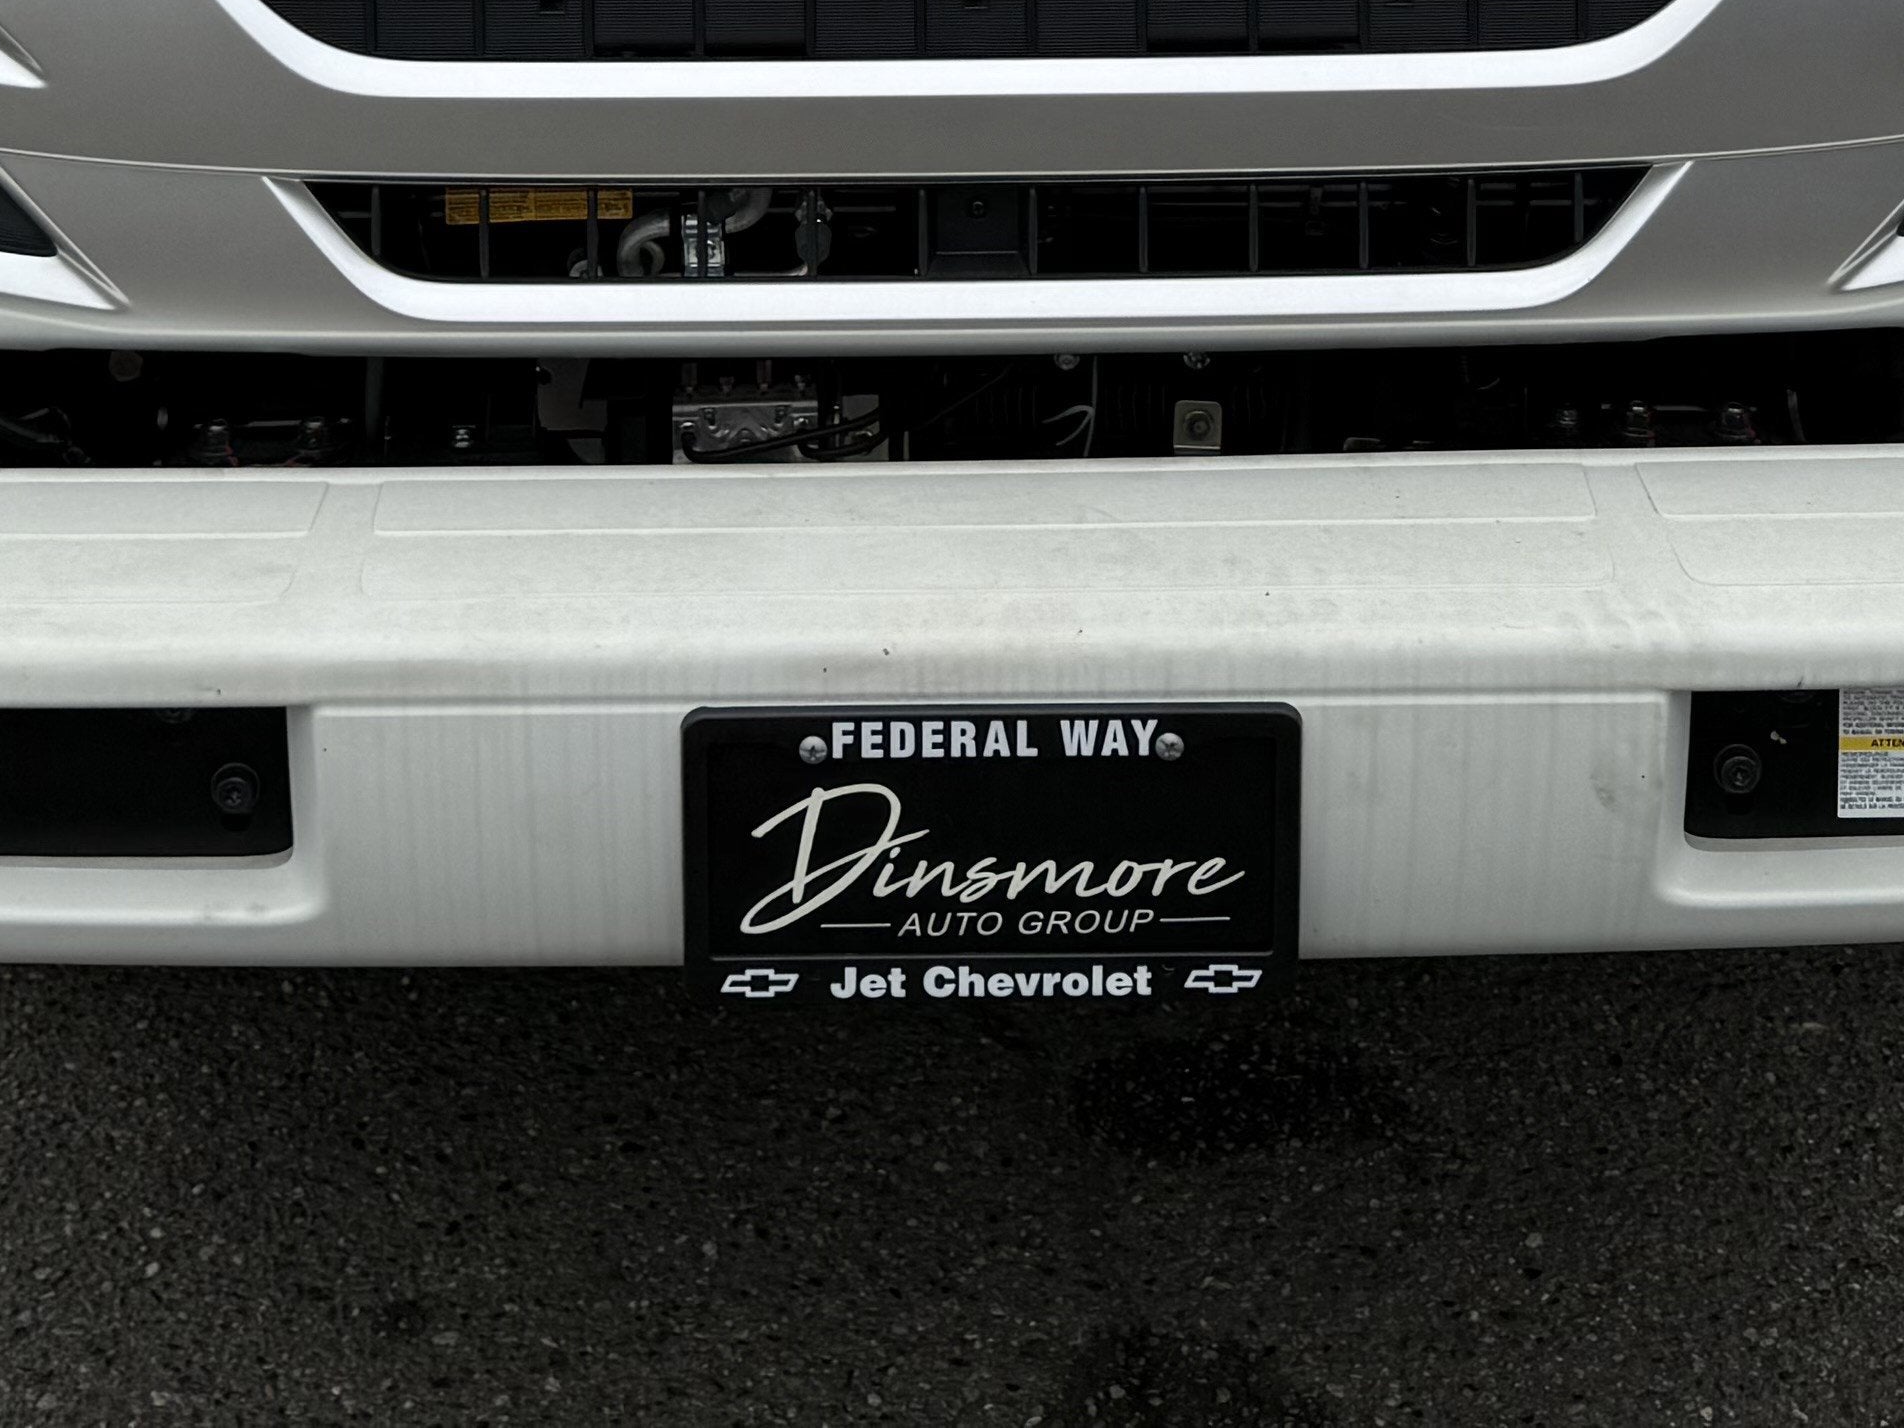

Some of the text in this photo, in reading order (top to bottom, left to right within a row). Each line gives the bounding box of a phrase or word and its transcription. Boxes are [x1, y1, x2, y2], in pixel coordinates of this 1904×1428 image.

[831, 718, 1159, 759] FEDERAL WAY
[739, 782, 1247, 935] Dinsmore
[897, 908, 1156, 937] AUTO GROUP
[830, 964, 1153, 999] Jet Chevrolet
